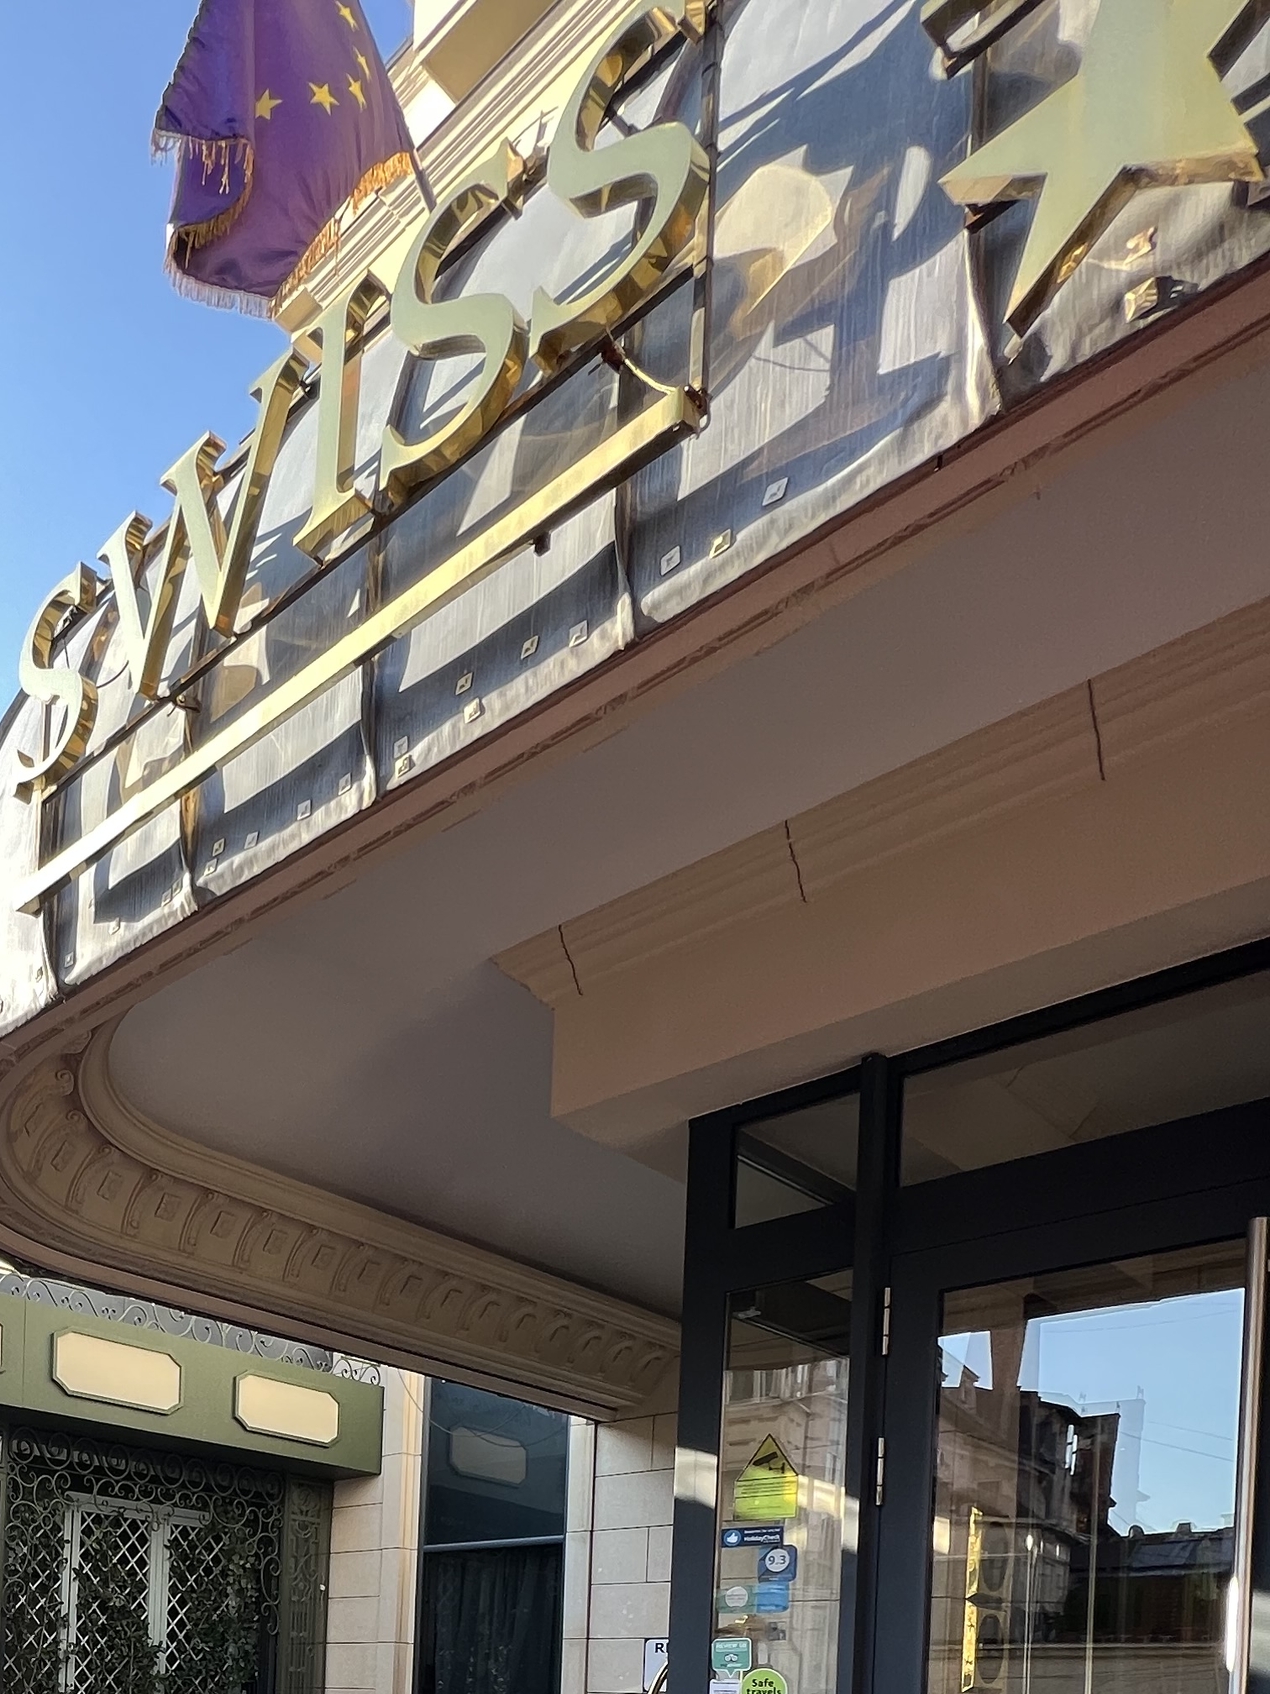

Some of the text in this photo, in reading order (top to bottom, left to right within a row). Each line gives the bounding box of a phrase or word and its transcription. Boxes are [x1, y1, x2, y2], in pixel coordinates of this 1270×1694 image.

[13, 0, 714, 804] SWISS
[768, 1555, 787, 1565] 9.3
[655, 1643, 668, 1653] R
[752, 1678, 774, 1687] Safe
